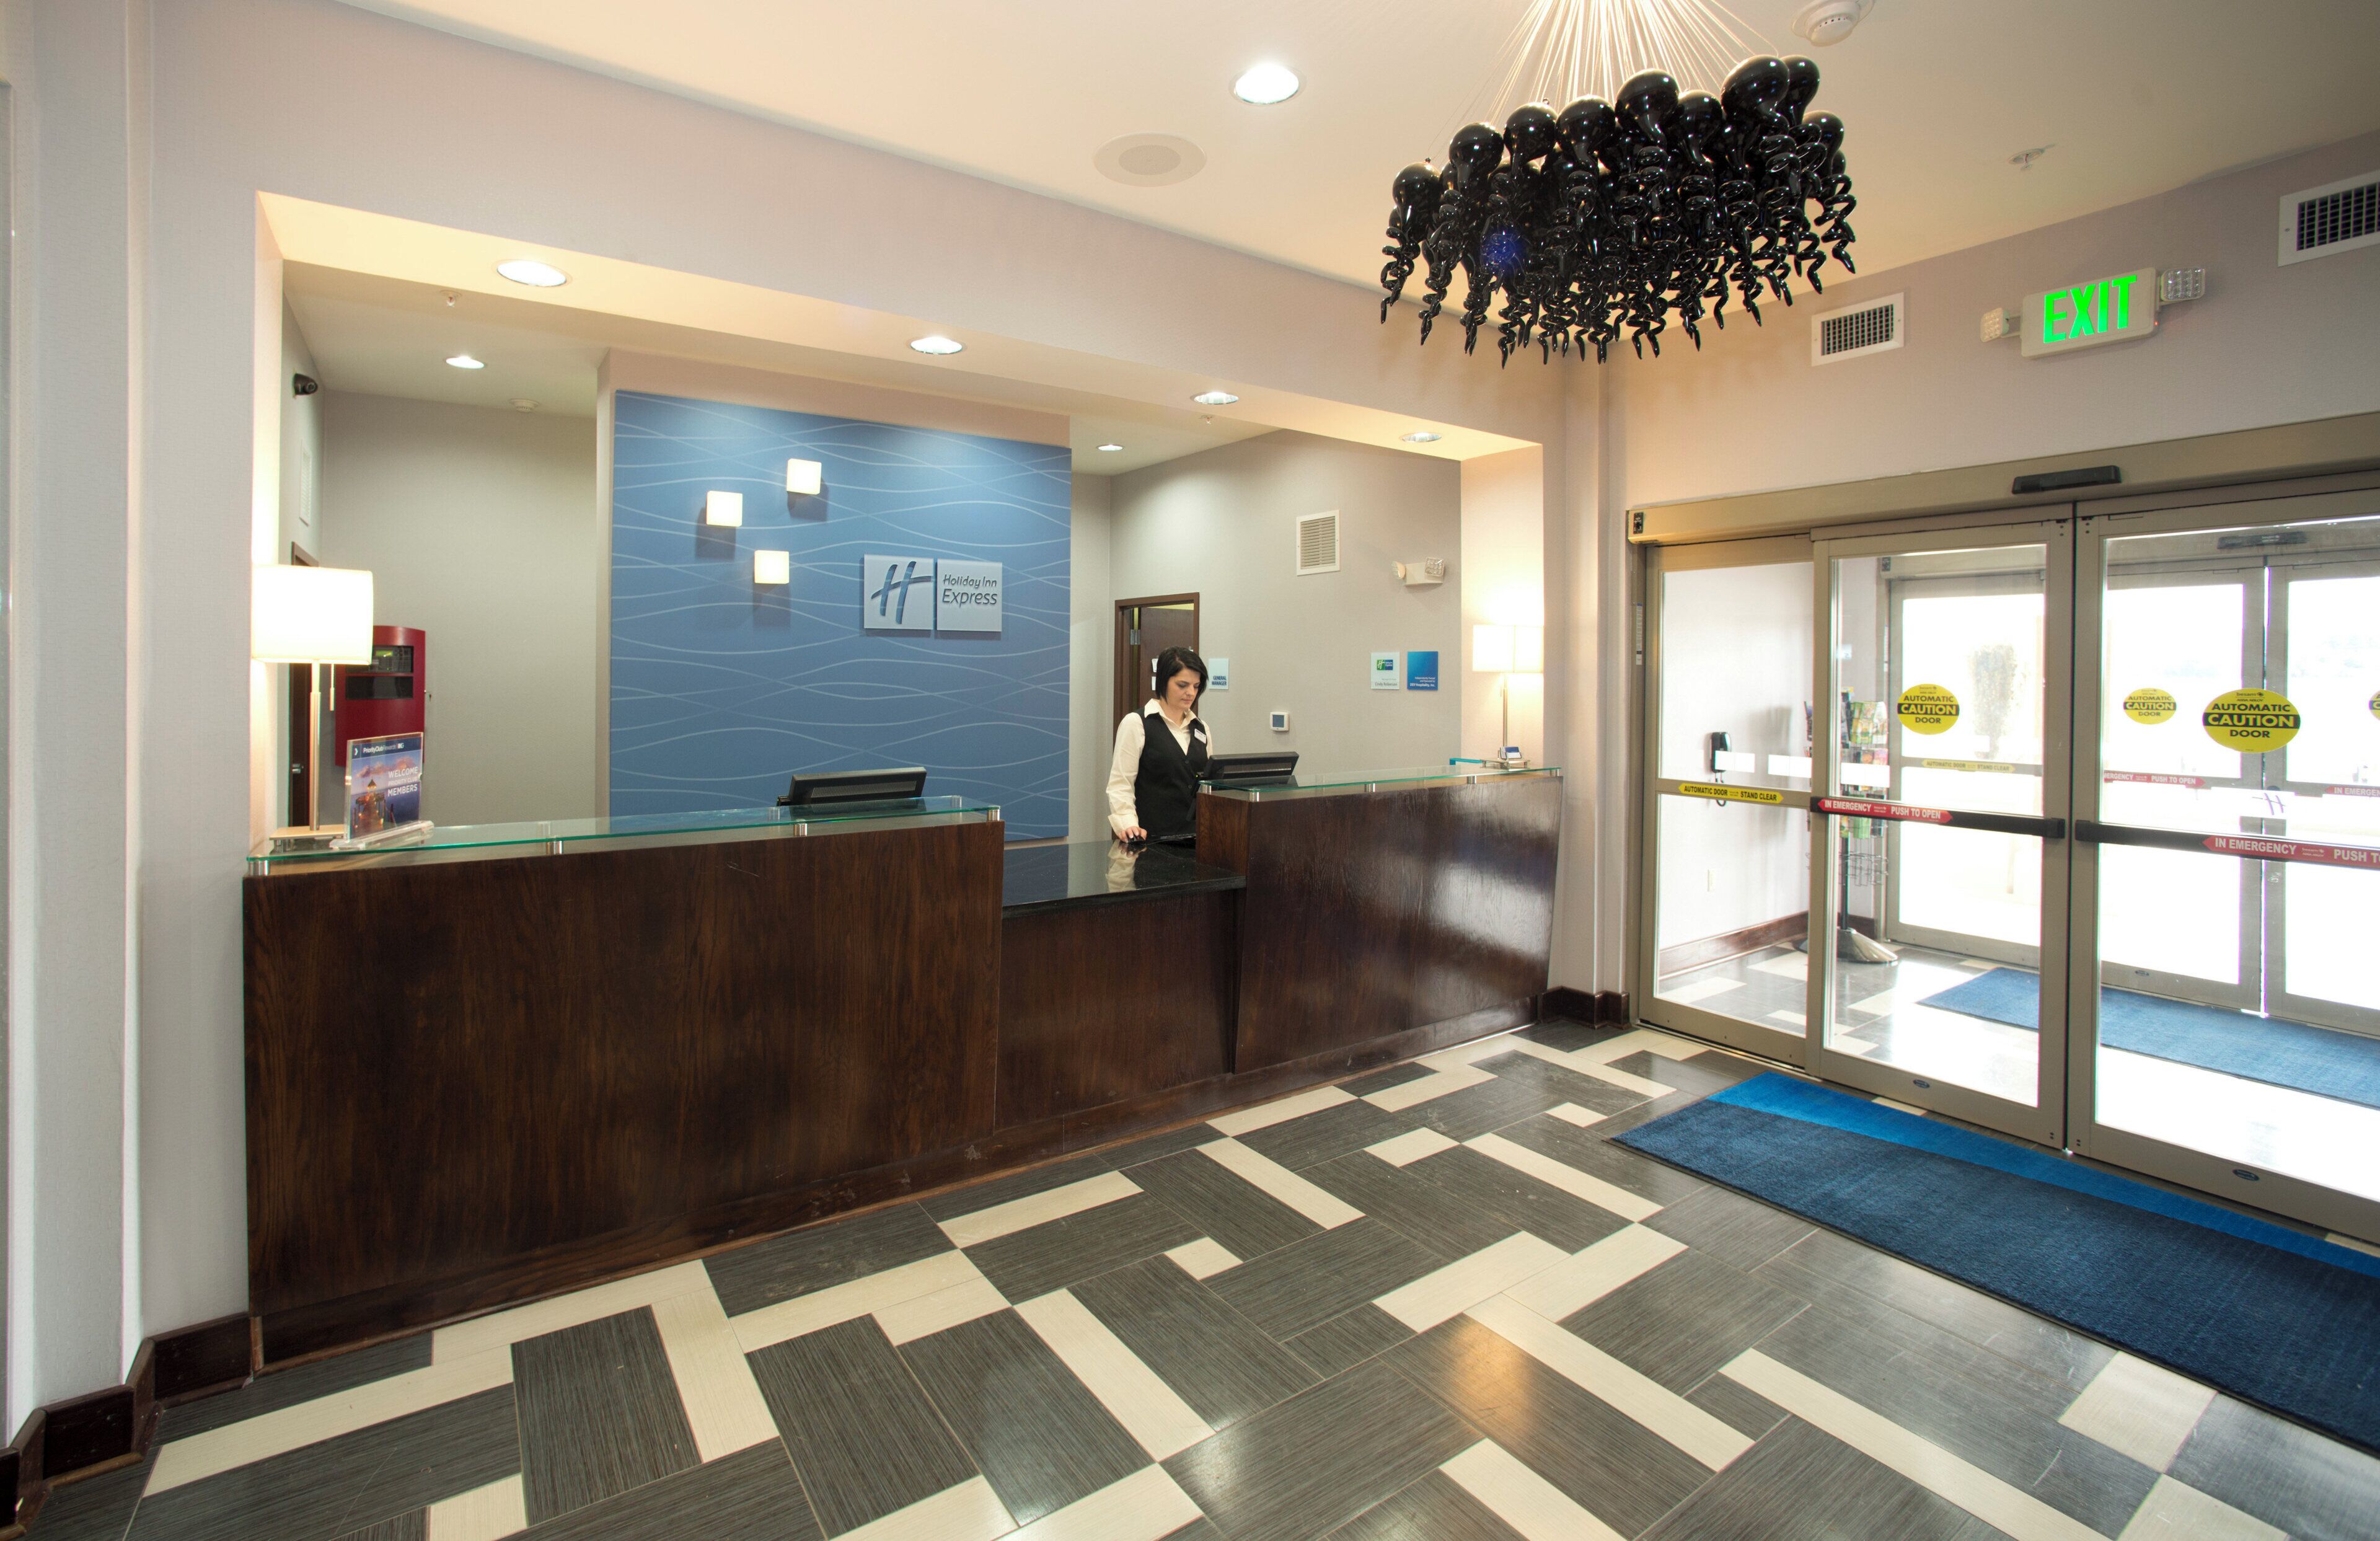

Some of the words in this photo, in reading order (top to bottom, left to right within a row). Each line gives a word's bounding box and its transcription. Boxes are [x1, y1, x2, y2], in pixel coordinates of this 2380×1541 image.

[2043, 275, 2136, 343] EXIT
[943, 574, 981, 589] Holiday
[982, 576, 997, 587] Inn
[942, 588, 997, 608] Express
[1901, 704, 1956, 714] CAUTION
[2126, 702, 2175, 710] CAUTION
[2211, 704, 2290, 712] AUTOMATIC
[2208, 714, 2294, 727] CAUTION
[2230, 730, 2270, 738] DOOR
[388, 767, 418, 779] WELCOME
[388, 784, 418, 797] MEMBERS
[1684, 785, 1712, 794] AUTOMATIC
[1714, 788, 1728, 796] DOOR
[1740, 791, 1758, 800] STAND
[1760, 793, 1777, 801] CLEAR
[1825, 800, 1832, 808] IN
[1833, 801, 1872, 812] EMERGENCY
[1891, 806, 1910, 816] PUSH
[1911, 808, 1920, 817] TO
[1921, 809, 1941, 819] OPEN
[2215, 837, 2226, 849] IN
[2229, 839, 2297, 855] EMERGENCY
[2334, 849, 2367, 863] PUSH
